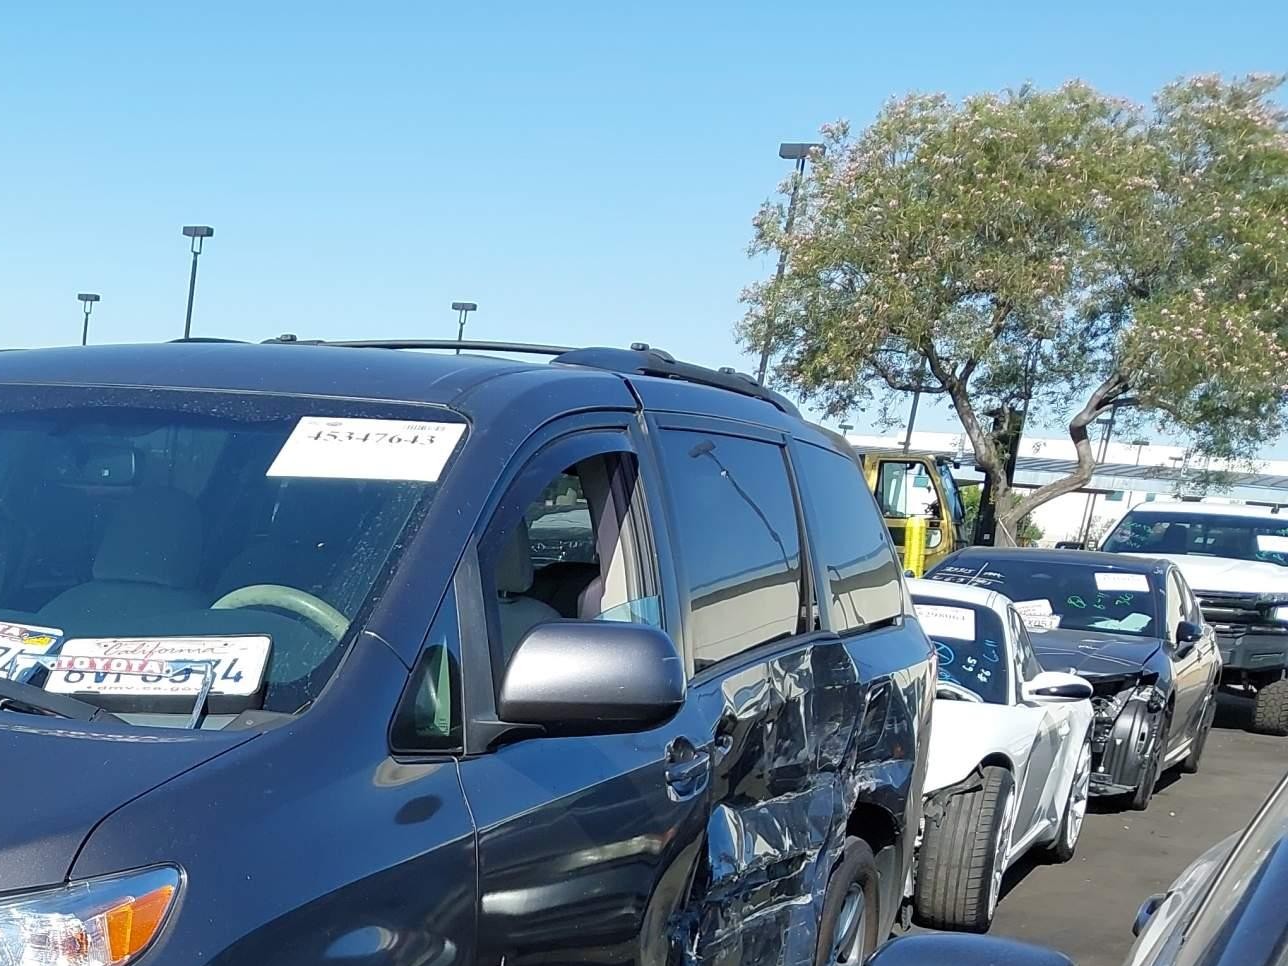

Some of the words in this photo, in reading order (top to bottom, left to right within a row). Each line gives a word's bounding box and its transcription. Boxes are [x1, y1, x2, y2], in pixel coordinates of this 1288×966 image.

[307, 430, 436, 446] 45347643
[103, 641, 218, 662] California
[57, 655, 165, 673] TOYOTA
